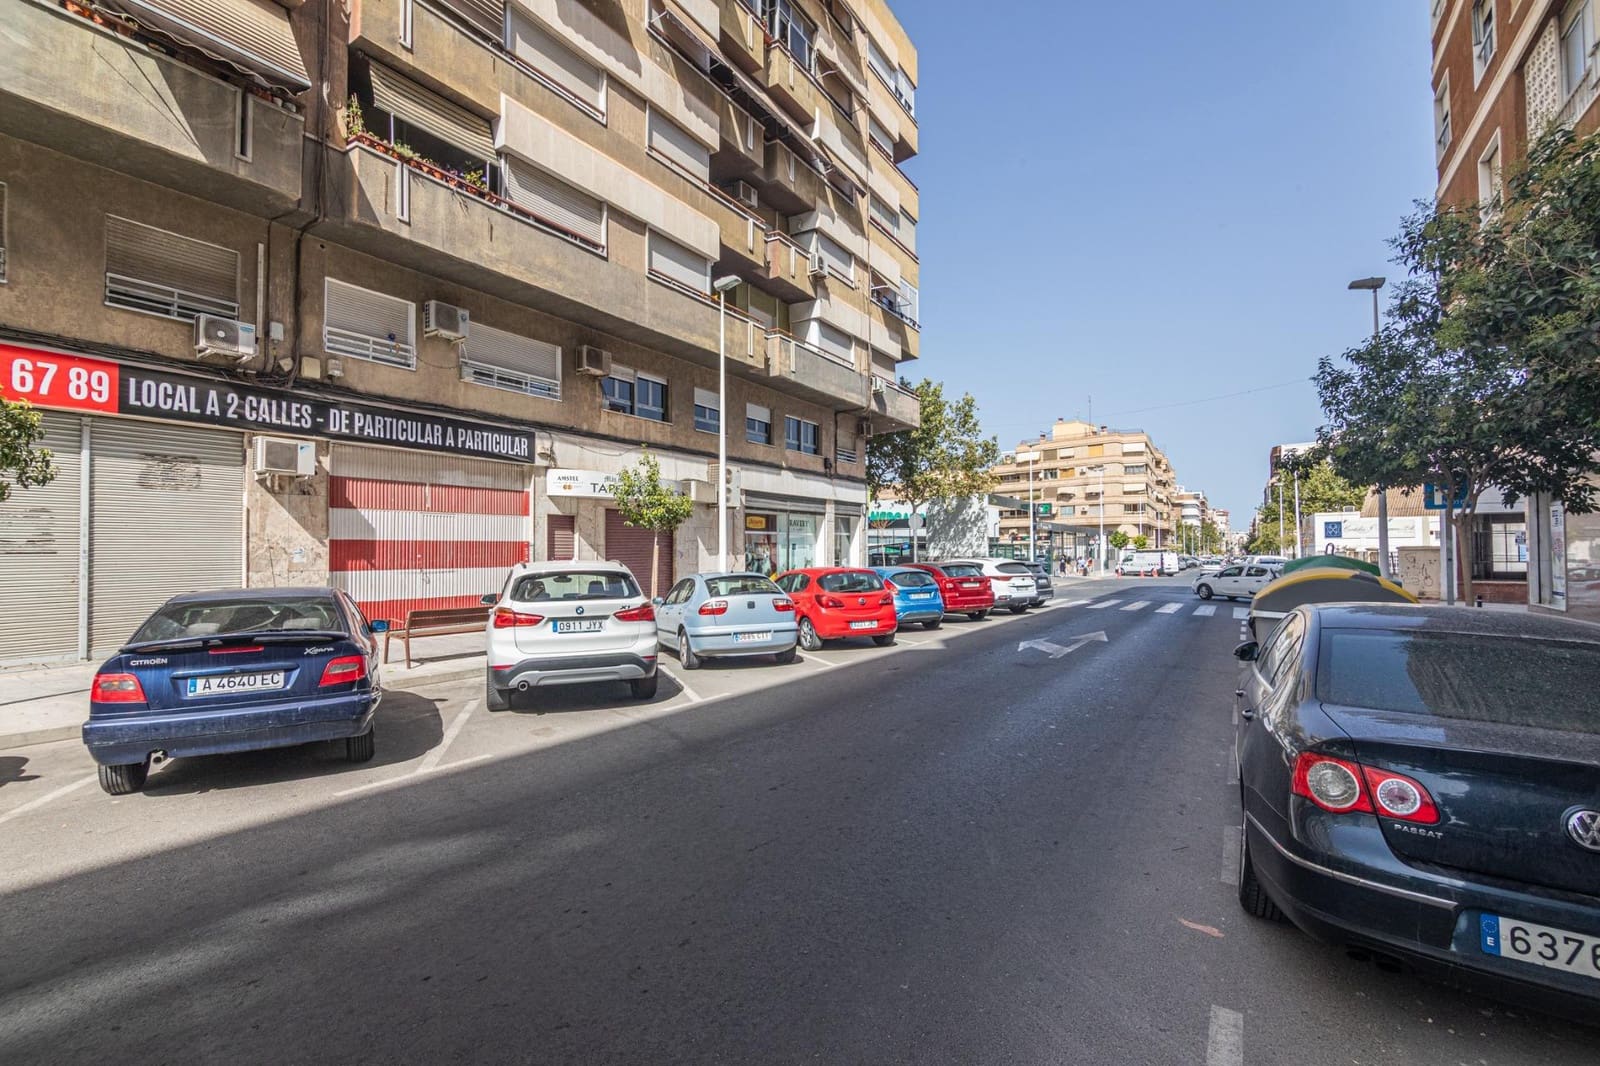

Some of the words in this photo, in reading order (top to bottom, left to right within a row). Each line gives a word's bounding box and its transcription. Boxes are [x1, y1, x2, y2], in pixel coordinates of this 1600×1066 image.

[11, 358, 58, 395] 67
[68, 366, 110, 403] 89
[128, 377, 200, 414] LOCAL
[205, 390, 220, 416] A
[226, 393, 239, 418] 2
[245, 396, 312, 429] CALLES
[329, 408, 350, 433] DE
[354, 412, 443, 446] PARTICULAR
[446, 425, 455, 447] A
[458, 428, 529, 457] PARTICULAR
[559, 621, 583, 631] 0911
[586, 620, 603, 630] JYX
[130, 657, 168, 666] CITROËN
[202, 681, 212, 691] A
[216, 674, 256, 690] 4640
[260, 672, 280, 686] EC
[1393, 823, 1444, 840] PASSAT
[1486, 936, 1495, 947] E
